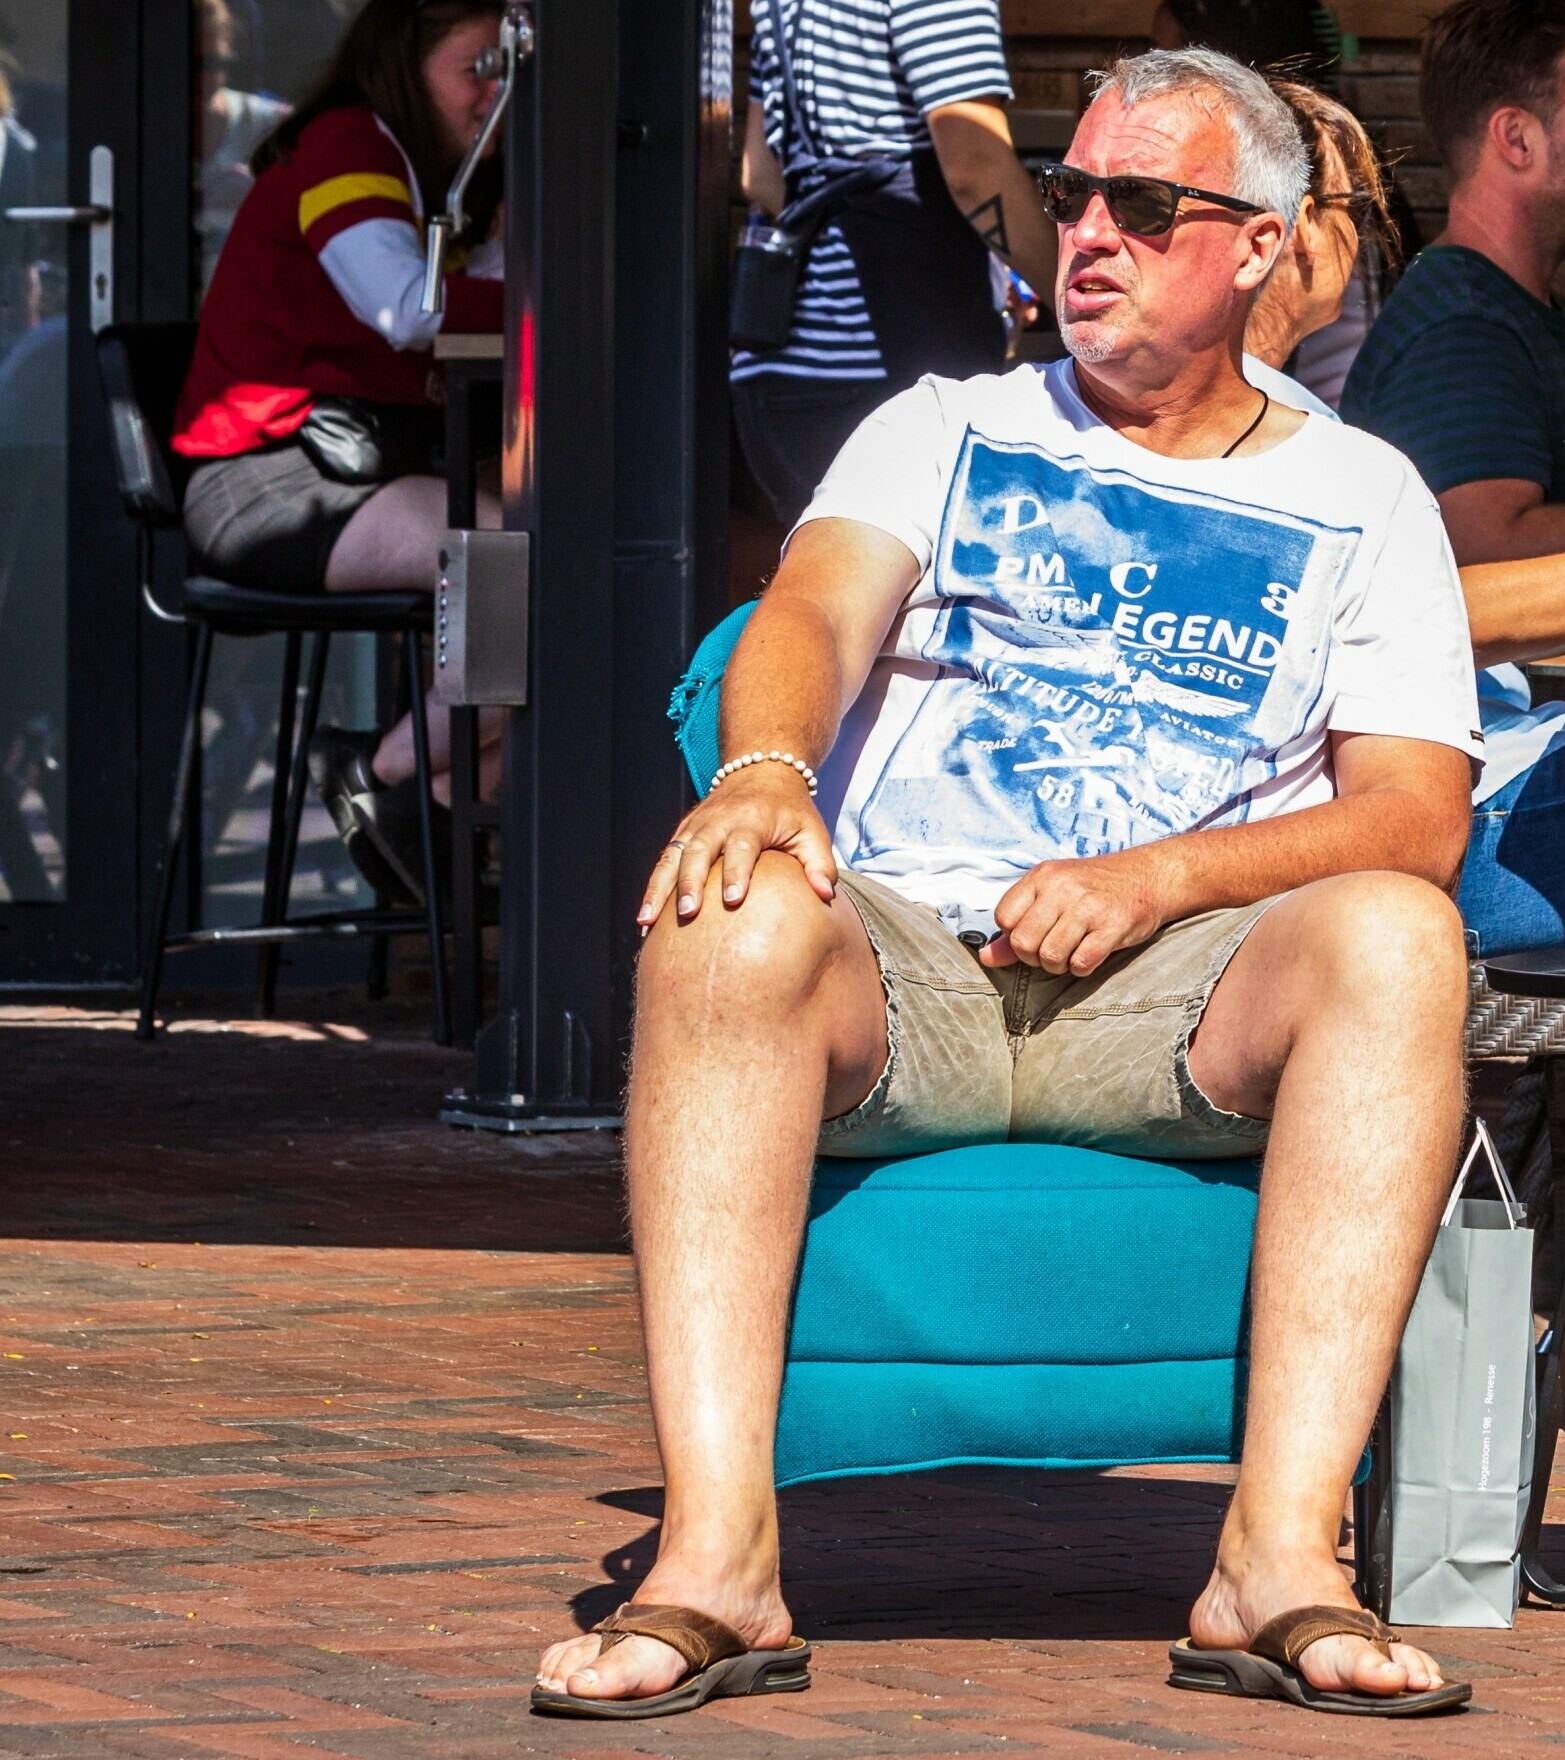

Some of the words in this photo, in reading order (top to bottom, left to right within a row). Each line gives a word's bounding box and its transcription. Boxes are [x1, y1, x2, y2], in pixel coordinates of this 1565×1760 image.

[996, 495, 1050, 534] D
[1109, 562, 1157, 598] C
[1134, 651, 1244, 690] CLASSIC
[977, 737, 1018, 752] TRADE
[1160, 702, 1240, 748] AVIATOR
[1037, 775, 1076, 808] 58
[1484, 1364, 1496, 1404] Renesse
[1483, 1416, 1492, 1434] 198
[1478, 1436, 1491, 1491] Hogezoom
